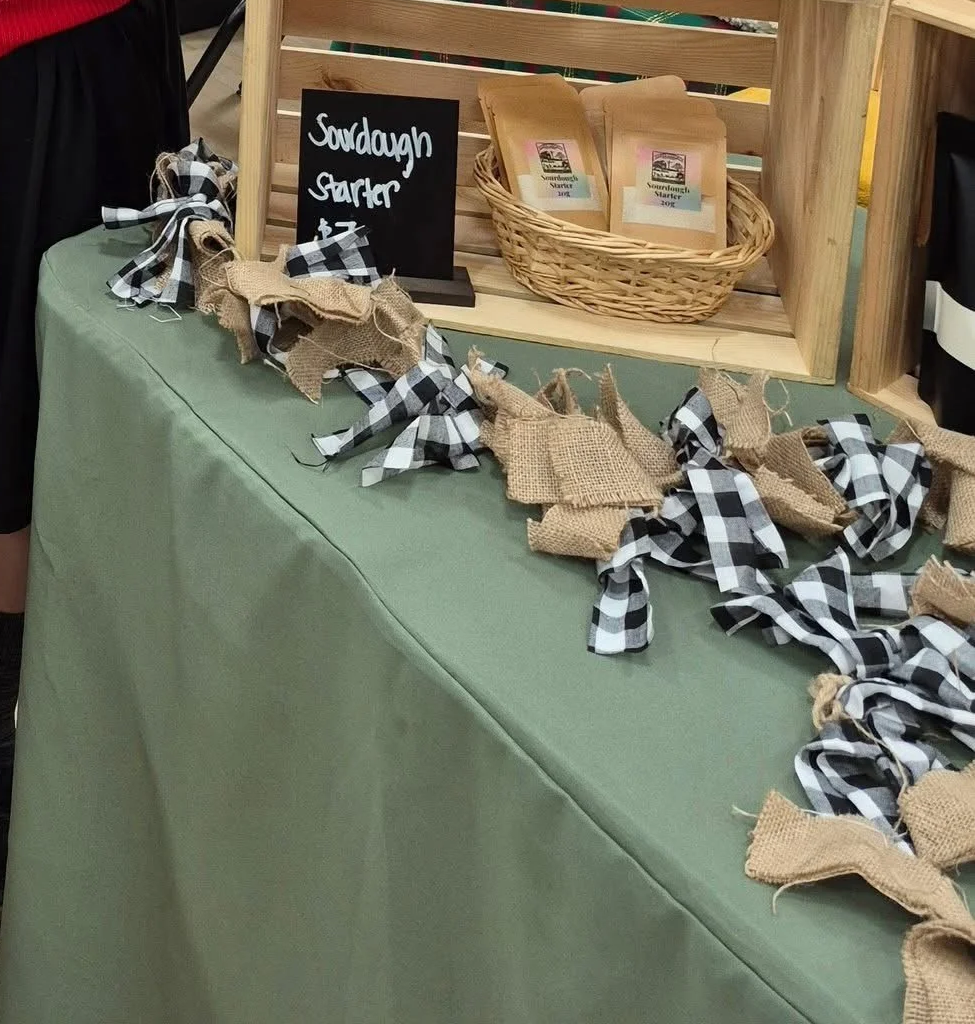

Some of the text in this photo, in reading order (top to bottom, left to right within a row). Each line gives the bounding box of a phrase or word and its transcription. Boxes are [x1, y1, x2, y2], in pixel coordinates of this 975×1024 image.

[308, 112, 433, 179] Sourdough
[541, 175, 579, 183] Sourdough
[308, 171, 401, 209] Starter
[646, 182, 690, 194] Sourdough
[654, 190, 683, 200] Starter
